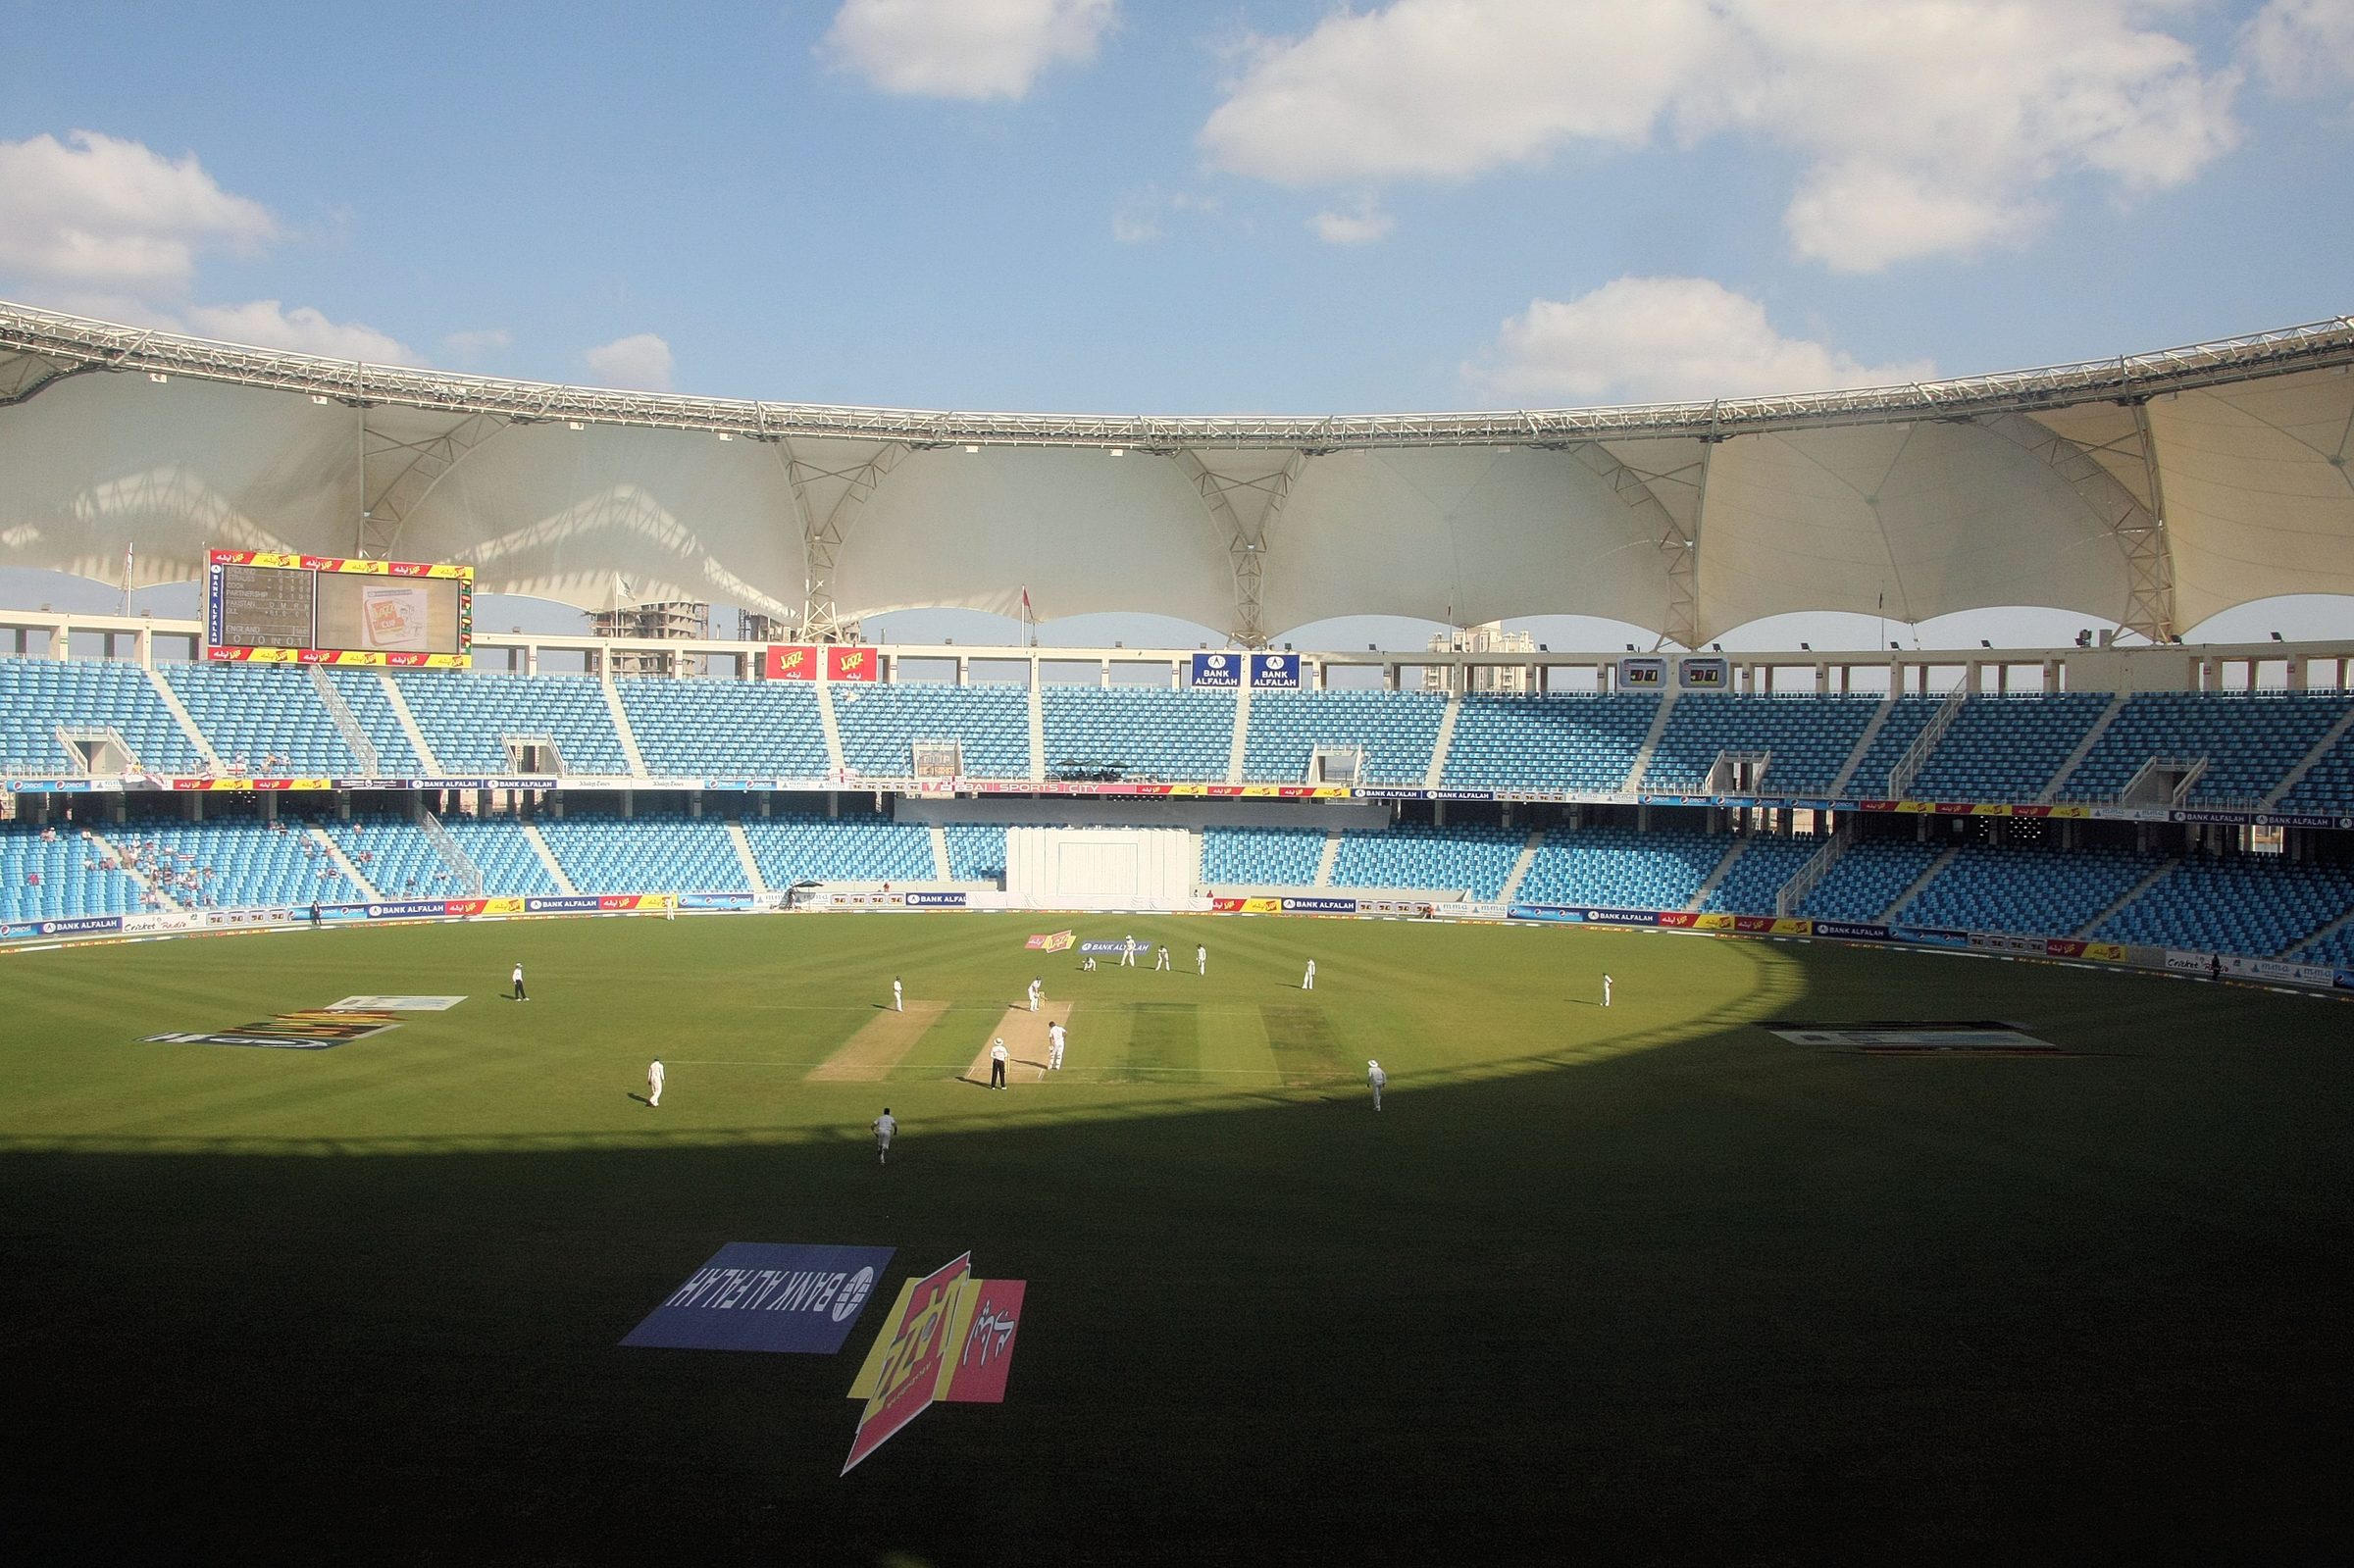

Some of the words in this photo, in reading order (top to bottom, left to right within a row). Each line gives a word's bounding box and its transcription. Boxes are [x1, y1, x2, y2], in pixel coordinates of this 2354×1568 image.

[1195, 678, 1238, 686] ALFALAH
[999, 784, 1059, 793] SPORTS
[1621, 913, 1654, 922] ALFALAH
[56, 922, 79, 931] BANK
[81, 920, 117, 929] ALFALAH
[125, 923, 156, 933] Cricket
[2168, 959, 2199, 970] Cricket
[665, 1268, 790, 1310] ALFALAH
[766, 1271, 847, 1312] BANK
